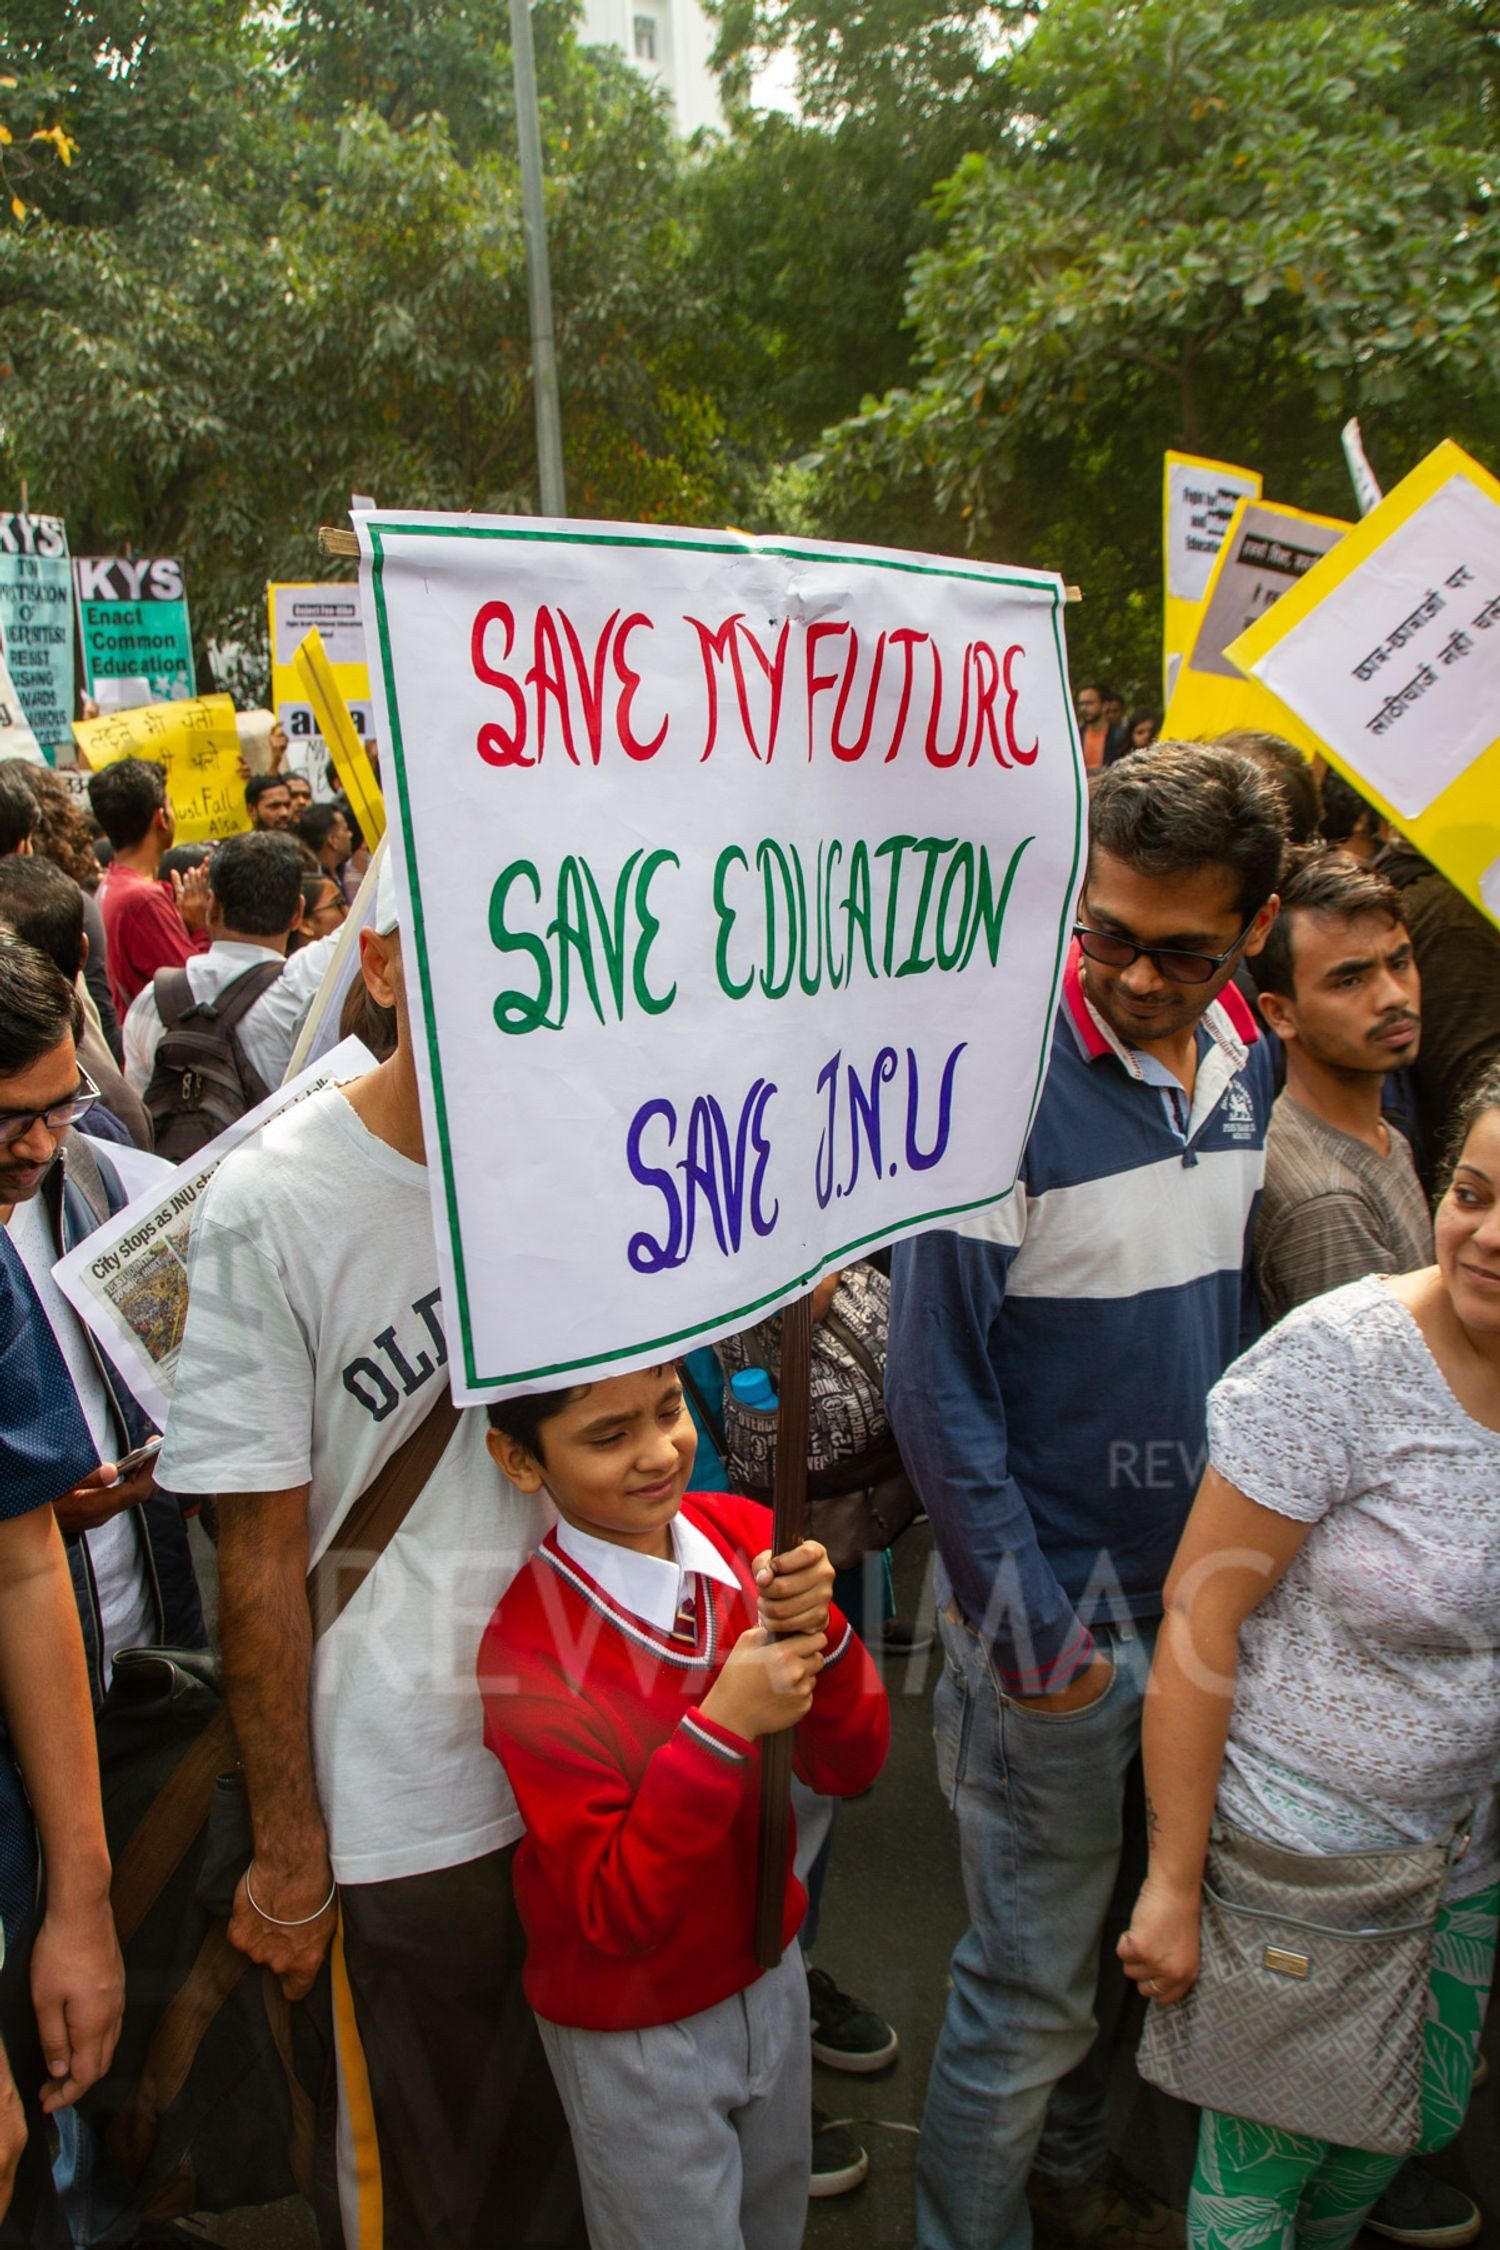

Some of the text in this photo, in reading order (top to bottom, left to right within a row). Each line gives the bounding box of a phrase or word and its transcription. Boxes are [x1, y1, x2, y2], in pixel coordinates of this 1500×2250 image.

[80, 558, 184, 600] KYS
[87, 607, 144, 626] Enact
[92, 656, 187, 675] Education
[471, 601, 1039, 769] SAVE MY FUTURE
[201, 785, 233, 817] Fall
[488, 836, 1037, 1036] SAVE EDUCATION
[627, 1078, 779, 1274] SAVE
[91, 1251, 121, 1281] City
[119, 1222, 157, 1258] stops
[154, 1208, 173, 1229] as
[170, 1185, 197, 1215] JNU
